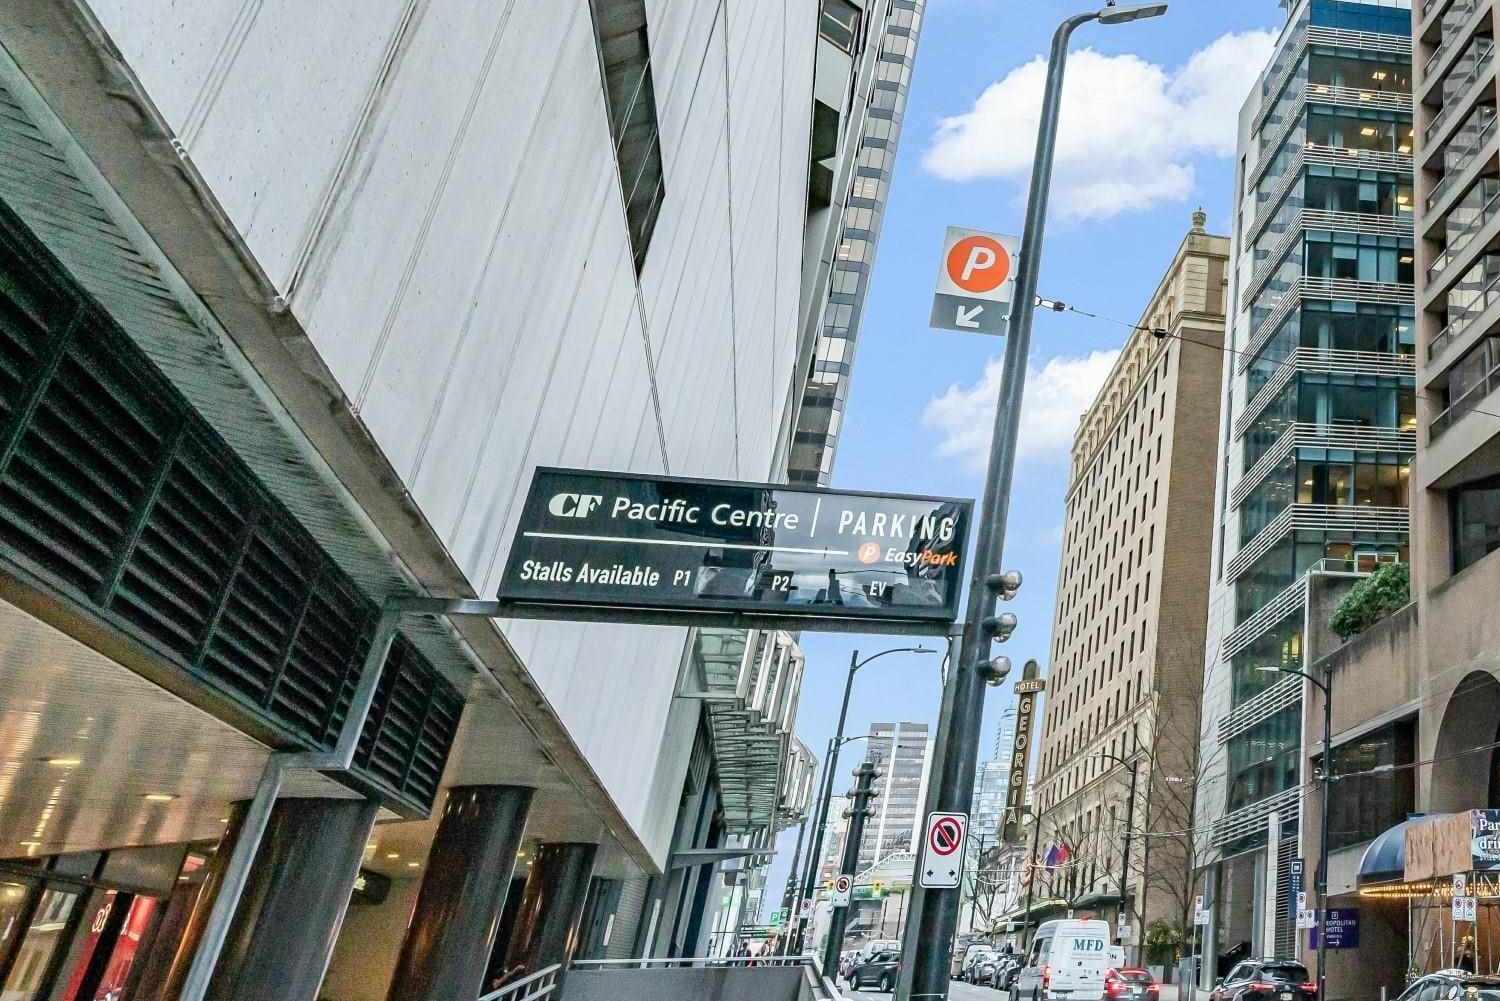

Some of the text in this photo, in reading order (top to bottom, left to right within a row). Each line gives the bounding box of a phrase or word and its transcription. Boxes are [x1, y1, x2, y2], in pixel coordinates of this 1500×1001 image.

[961, 246, 998, 281] P
[549, 493, 799, 530] CF Pacific Centre
[838, 509, 955, 541] PARKING
[884, 547, 957, 567] EasyPark
[520, 559, 887, 596] Stalls Available P1 P2 EV
[1014, 681, 1040, 690] HOTEL
[1005, 697, 1032, 825] GEORGIA
[1073, 939, 1104, 951] MFD
